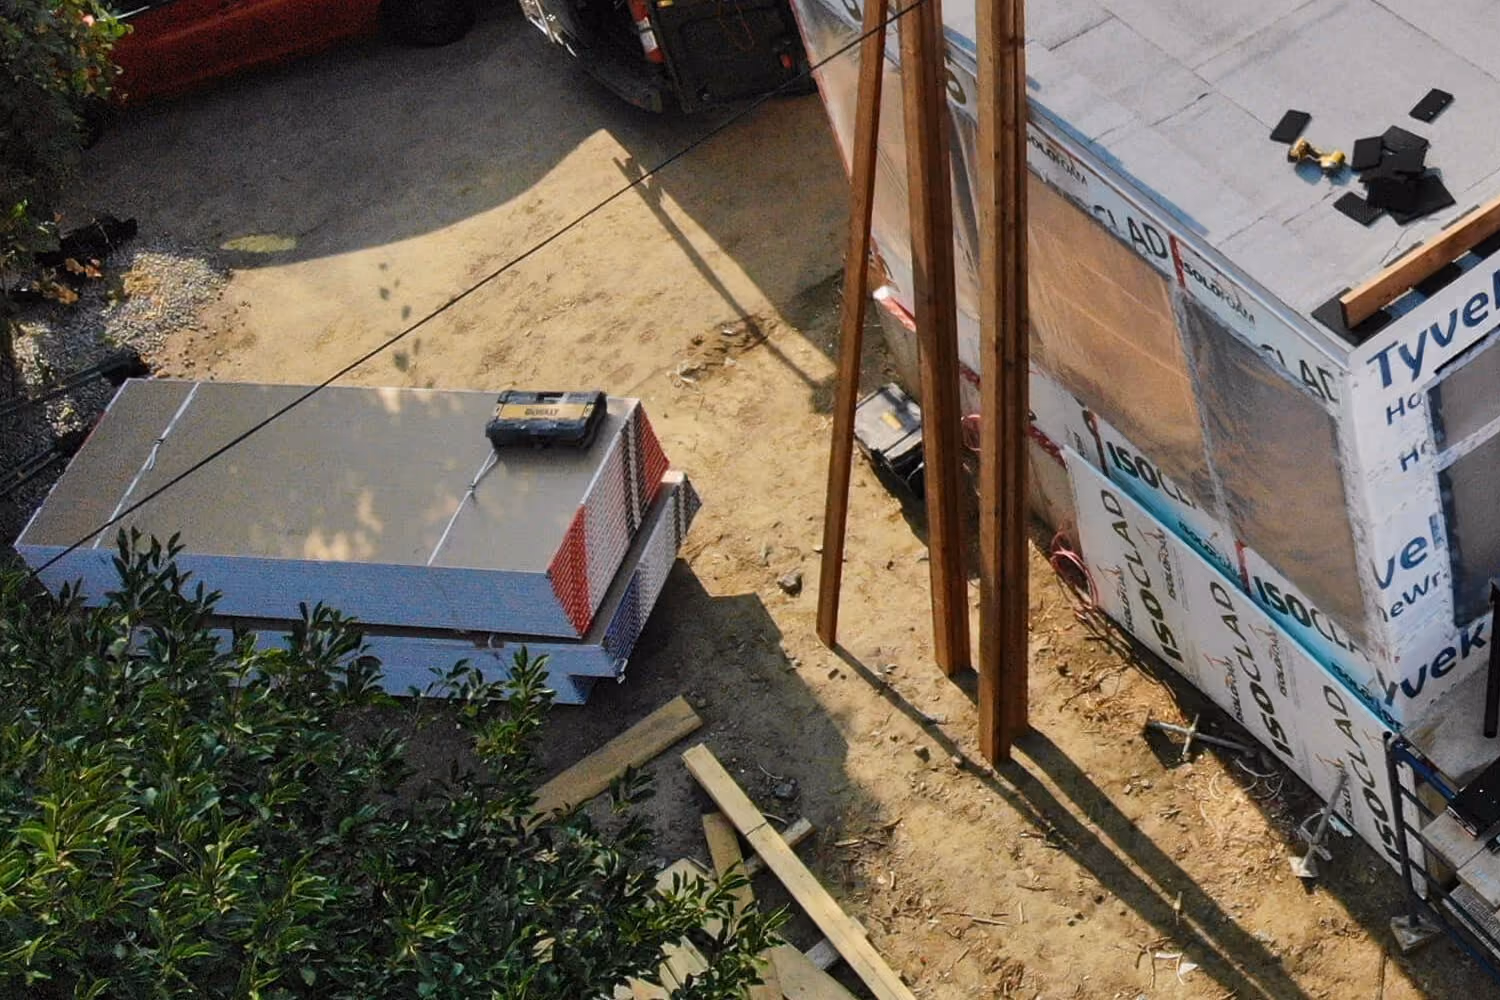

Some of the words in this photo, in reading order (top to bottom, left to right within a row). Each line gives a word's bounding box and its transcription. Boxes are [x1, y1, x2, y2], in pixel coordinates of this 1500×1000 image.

[1101, 489, 1184, 663] ISOCLAD
[1210, 581, 1295, 760] ISOCLAD
[1323, 685, 1401, 863] ISOCLAD
